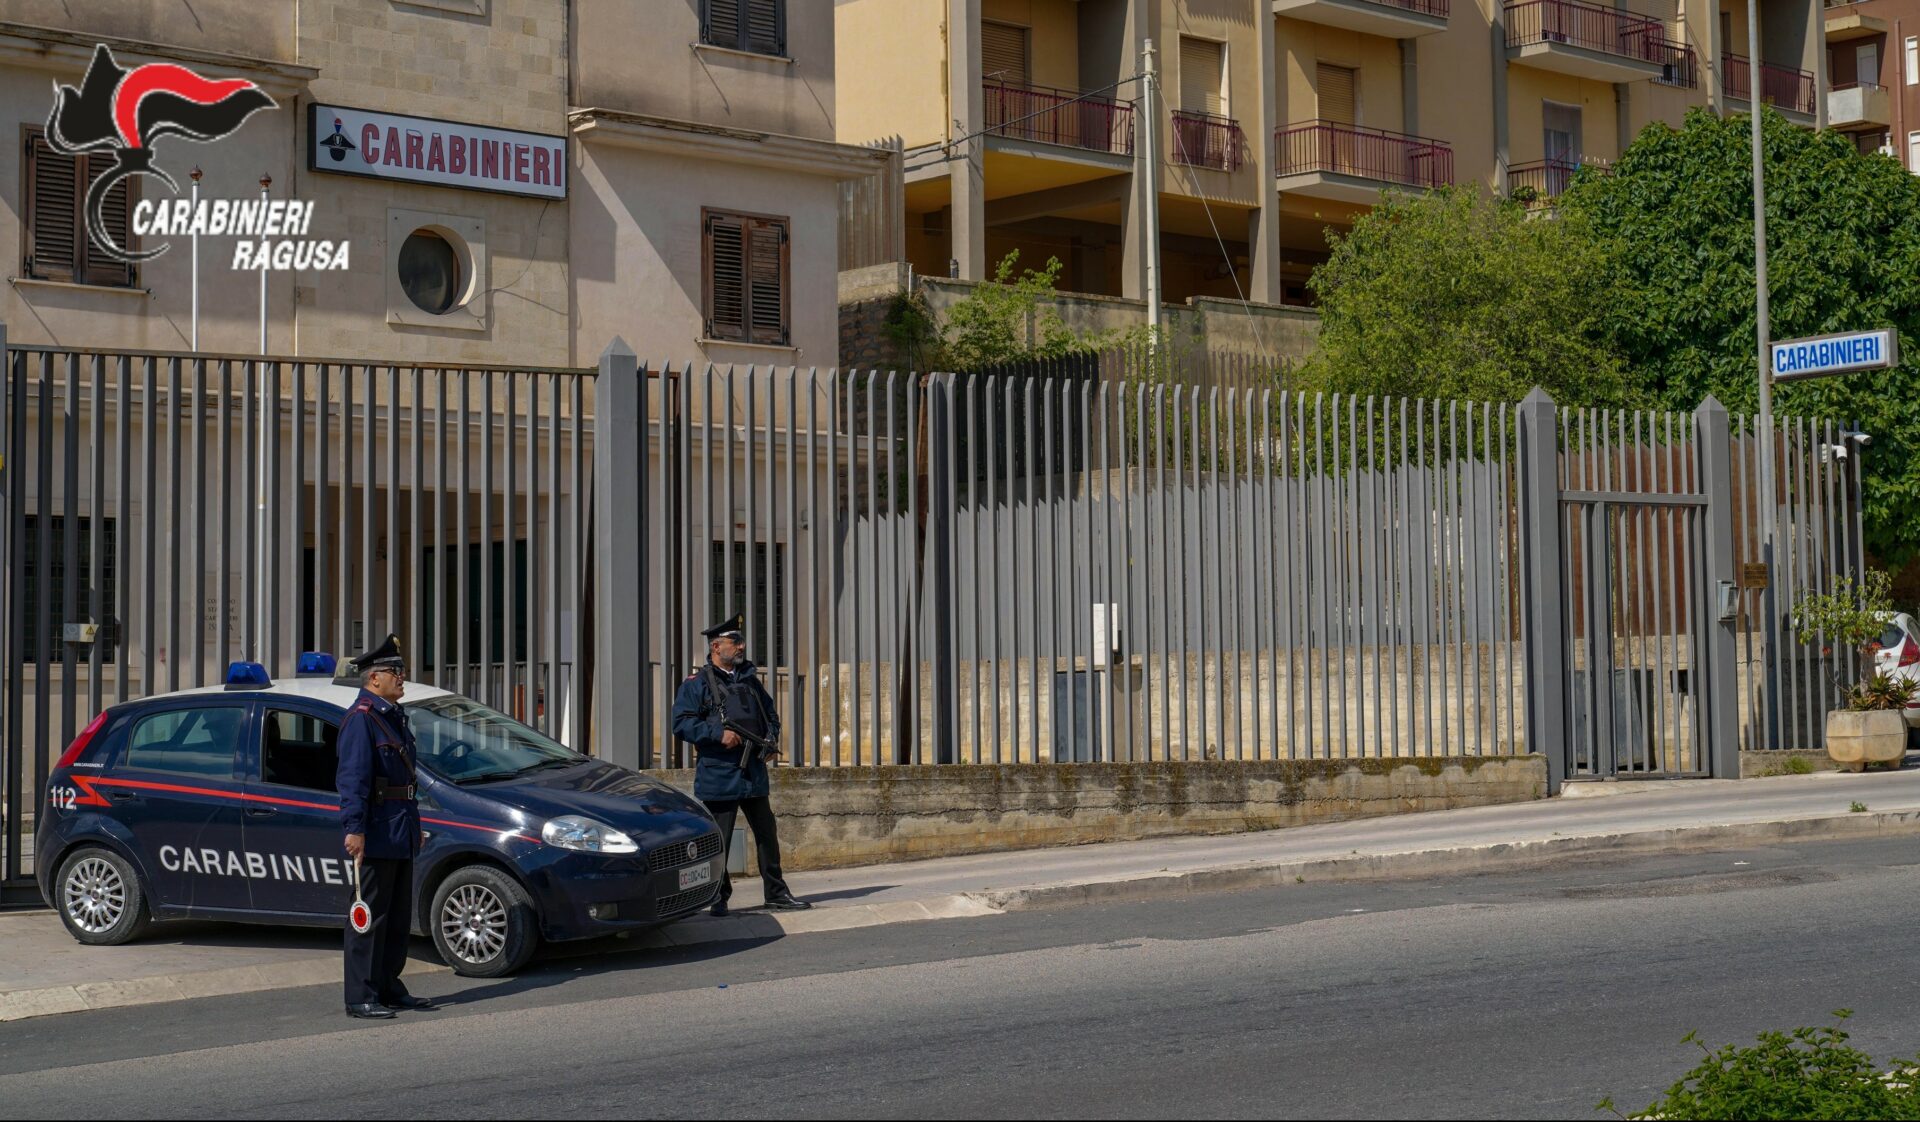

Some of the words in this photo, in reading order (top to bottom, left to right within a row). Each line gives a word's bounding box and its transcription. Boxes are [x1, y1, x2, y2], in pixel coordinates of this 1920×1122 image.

[361, 122, 562, 187] CARABINIERI
[1776, 337, 1879, 372] CARABINIERI
[50, 785, 77, 810] 112
